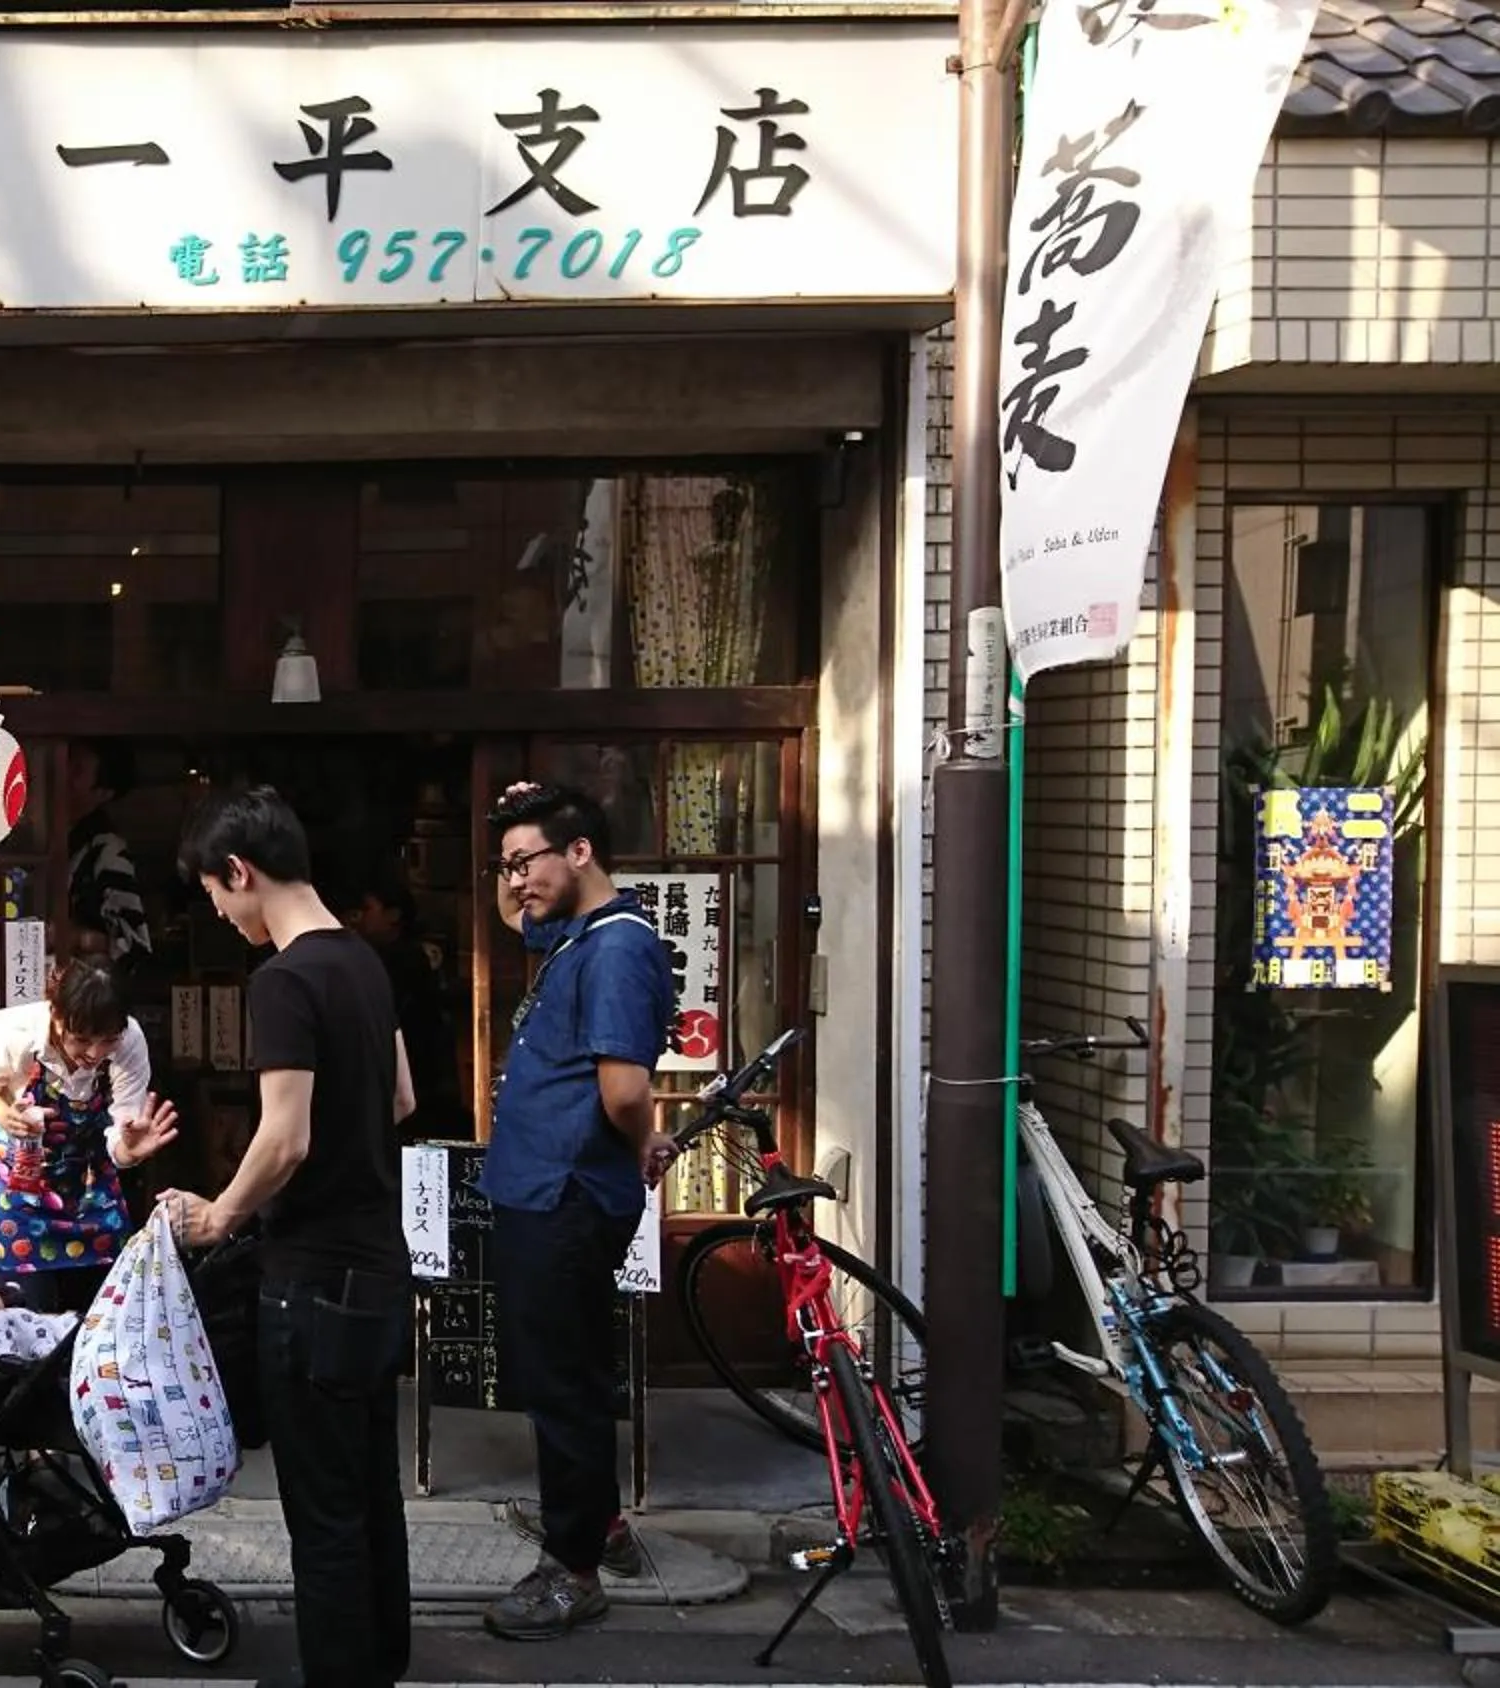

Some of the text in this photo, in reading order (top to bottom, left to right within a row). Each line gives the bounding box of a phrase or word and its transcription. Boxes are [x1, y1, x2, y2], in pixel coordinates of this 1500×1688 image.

[168, 233, 291, 286] 電話
[409, 1180, 433, 1233] チュロス
